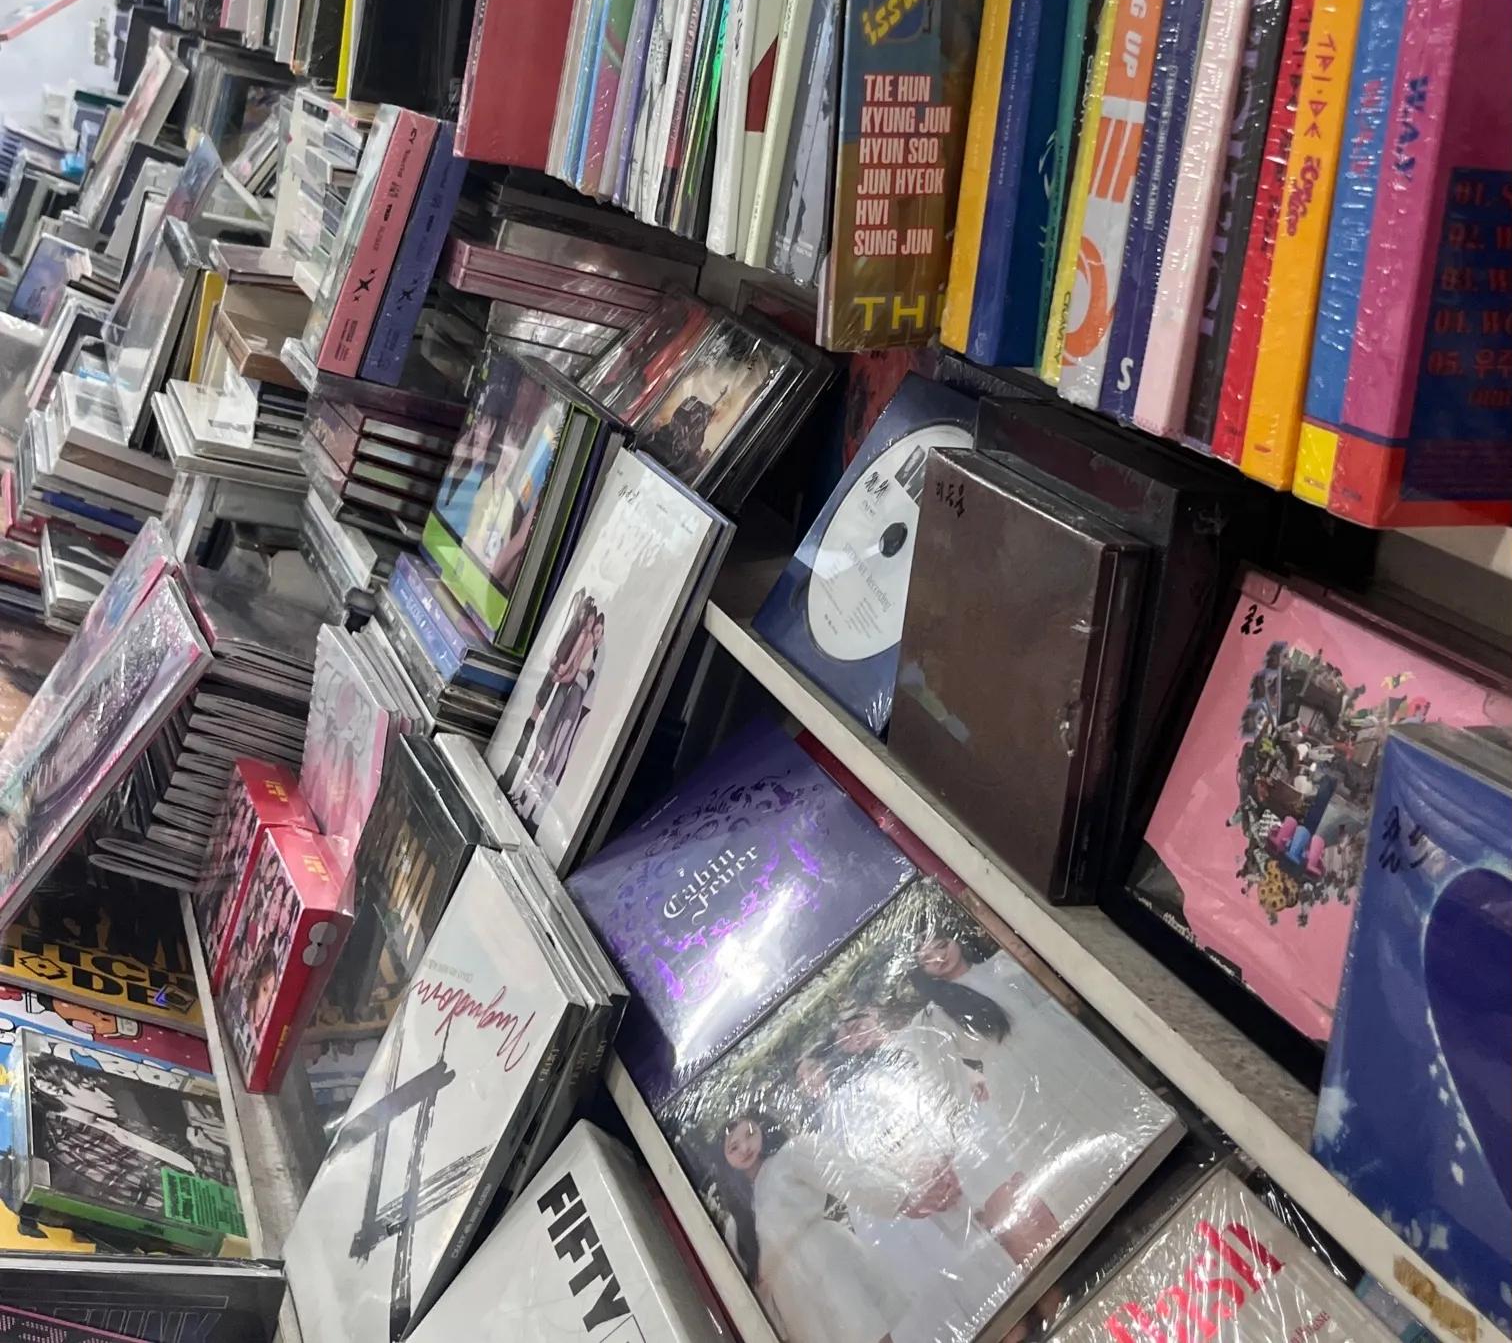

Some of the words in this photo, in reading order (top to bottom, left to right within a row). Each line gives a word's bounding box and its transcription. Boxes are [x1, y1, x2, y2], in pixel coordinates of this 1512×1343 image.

[1121, 30, 1143, 79] UP
[863, 75, 894, 102] TAE
[898, 75, 931, 103] HUN
[860, 107, 915, 134] KYUNG
[919, 107, 951, 134] JUN
[859, 138, 905, 164] HYUN
[907, 138, 938, 164] SOO
[857, 169, 891, 195] JUN
[895, 168, 944, 195] HYEOK
[855, 200, 889, 226] HWI
[853, 230, 898, 256] SUNG
[901, 229, 933, 255] JUN
[852, 296, 946, 331] TH
[663, 849, 736, 919] Cabin
[691, 844, 760, 926] Fever
[536, 1170, 628, 1338] FIFTY
